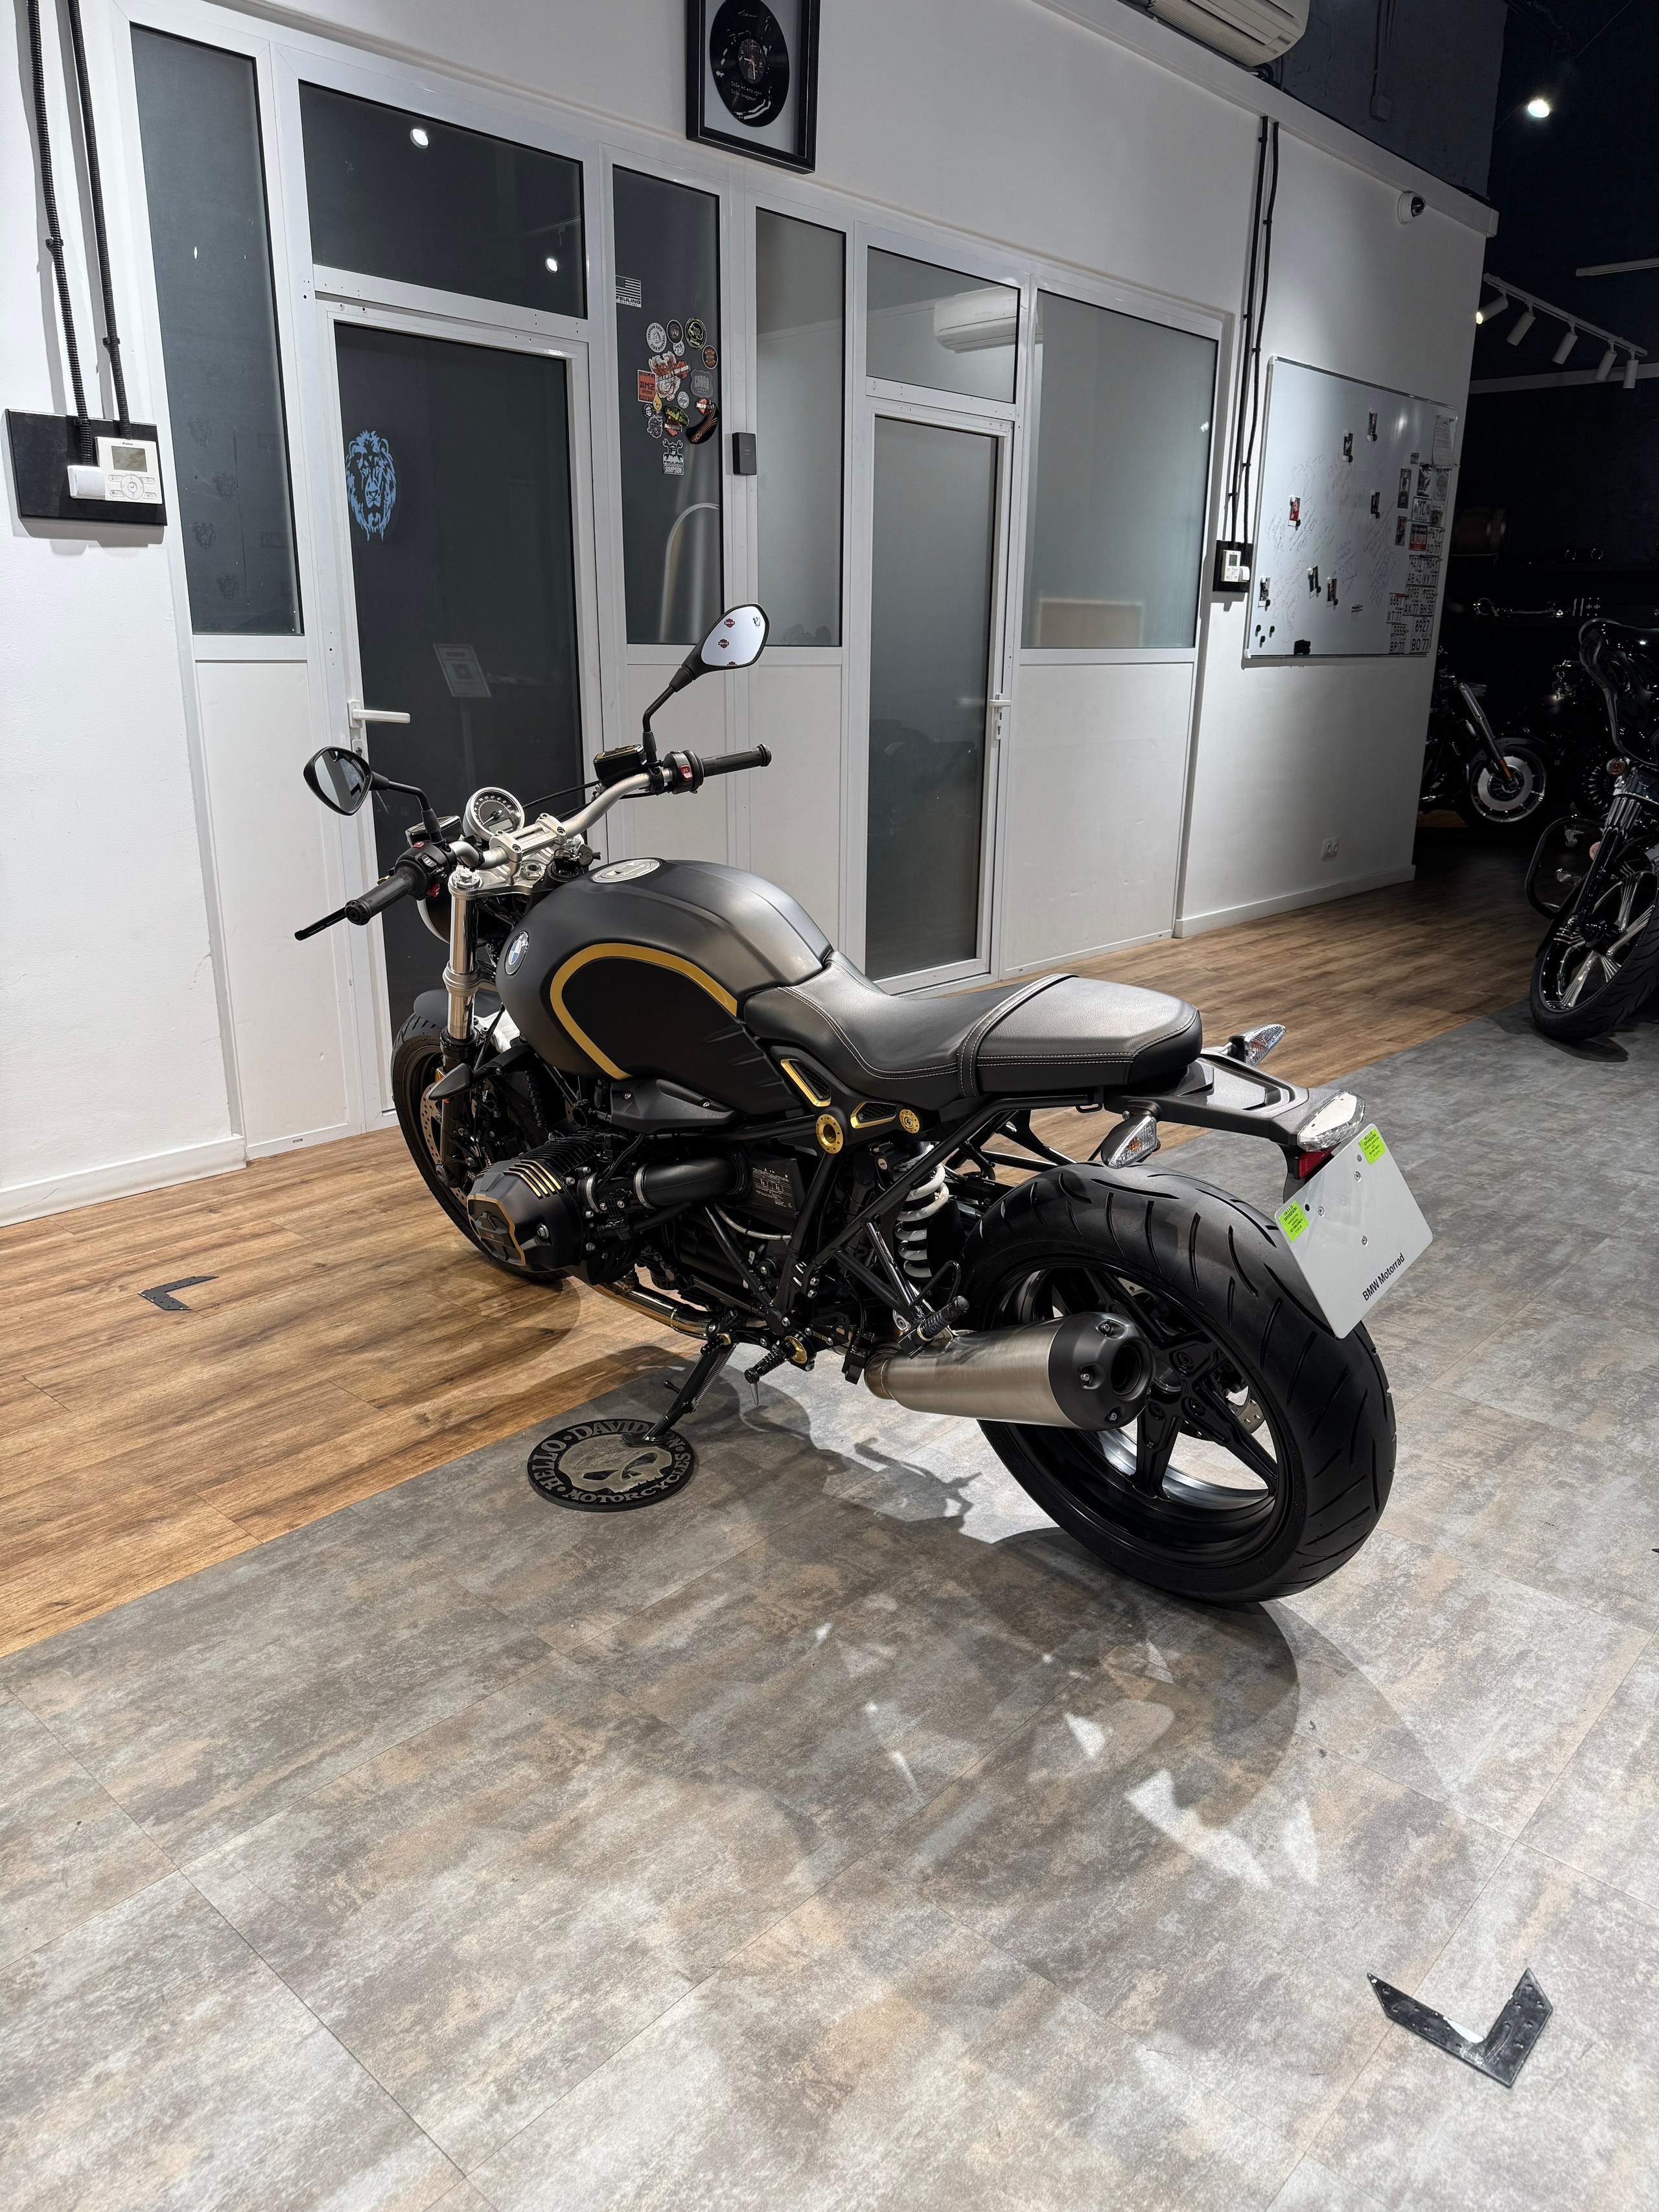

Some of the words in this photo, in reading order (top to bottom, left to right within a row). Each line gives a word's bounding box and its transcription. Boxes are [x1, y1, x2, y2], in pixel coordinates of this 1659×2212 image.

[616, 296, 641, 305] FEULING
[665, 465, 682, 474] SIMPSON
[1362, 1279, 1380, 1301] BMW
[1377, 1252, 1405, 1285] Motorrad
[567, 1421, 686, 1448] DAVIDON
[531, 1439, 567, 1490] HELLO
[561, 1452, 691, 1503] MOTORCYCLES
